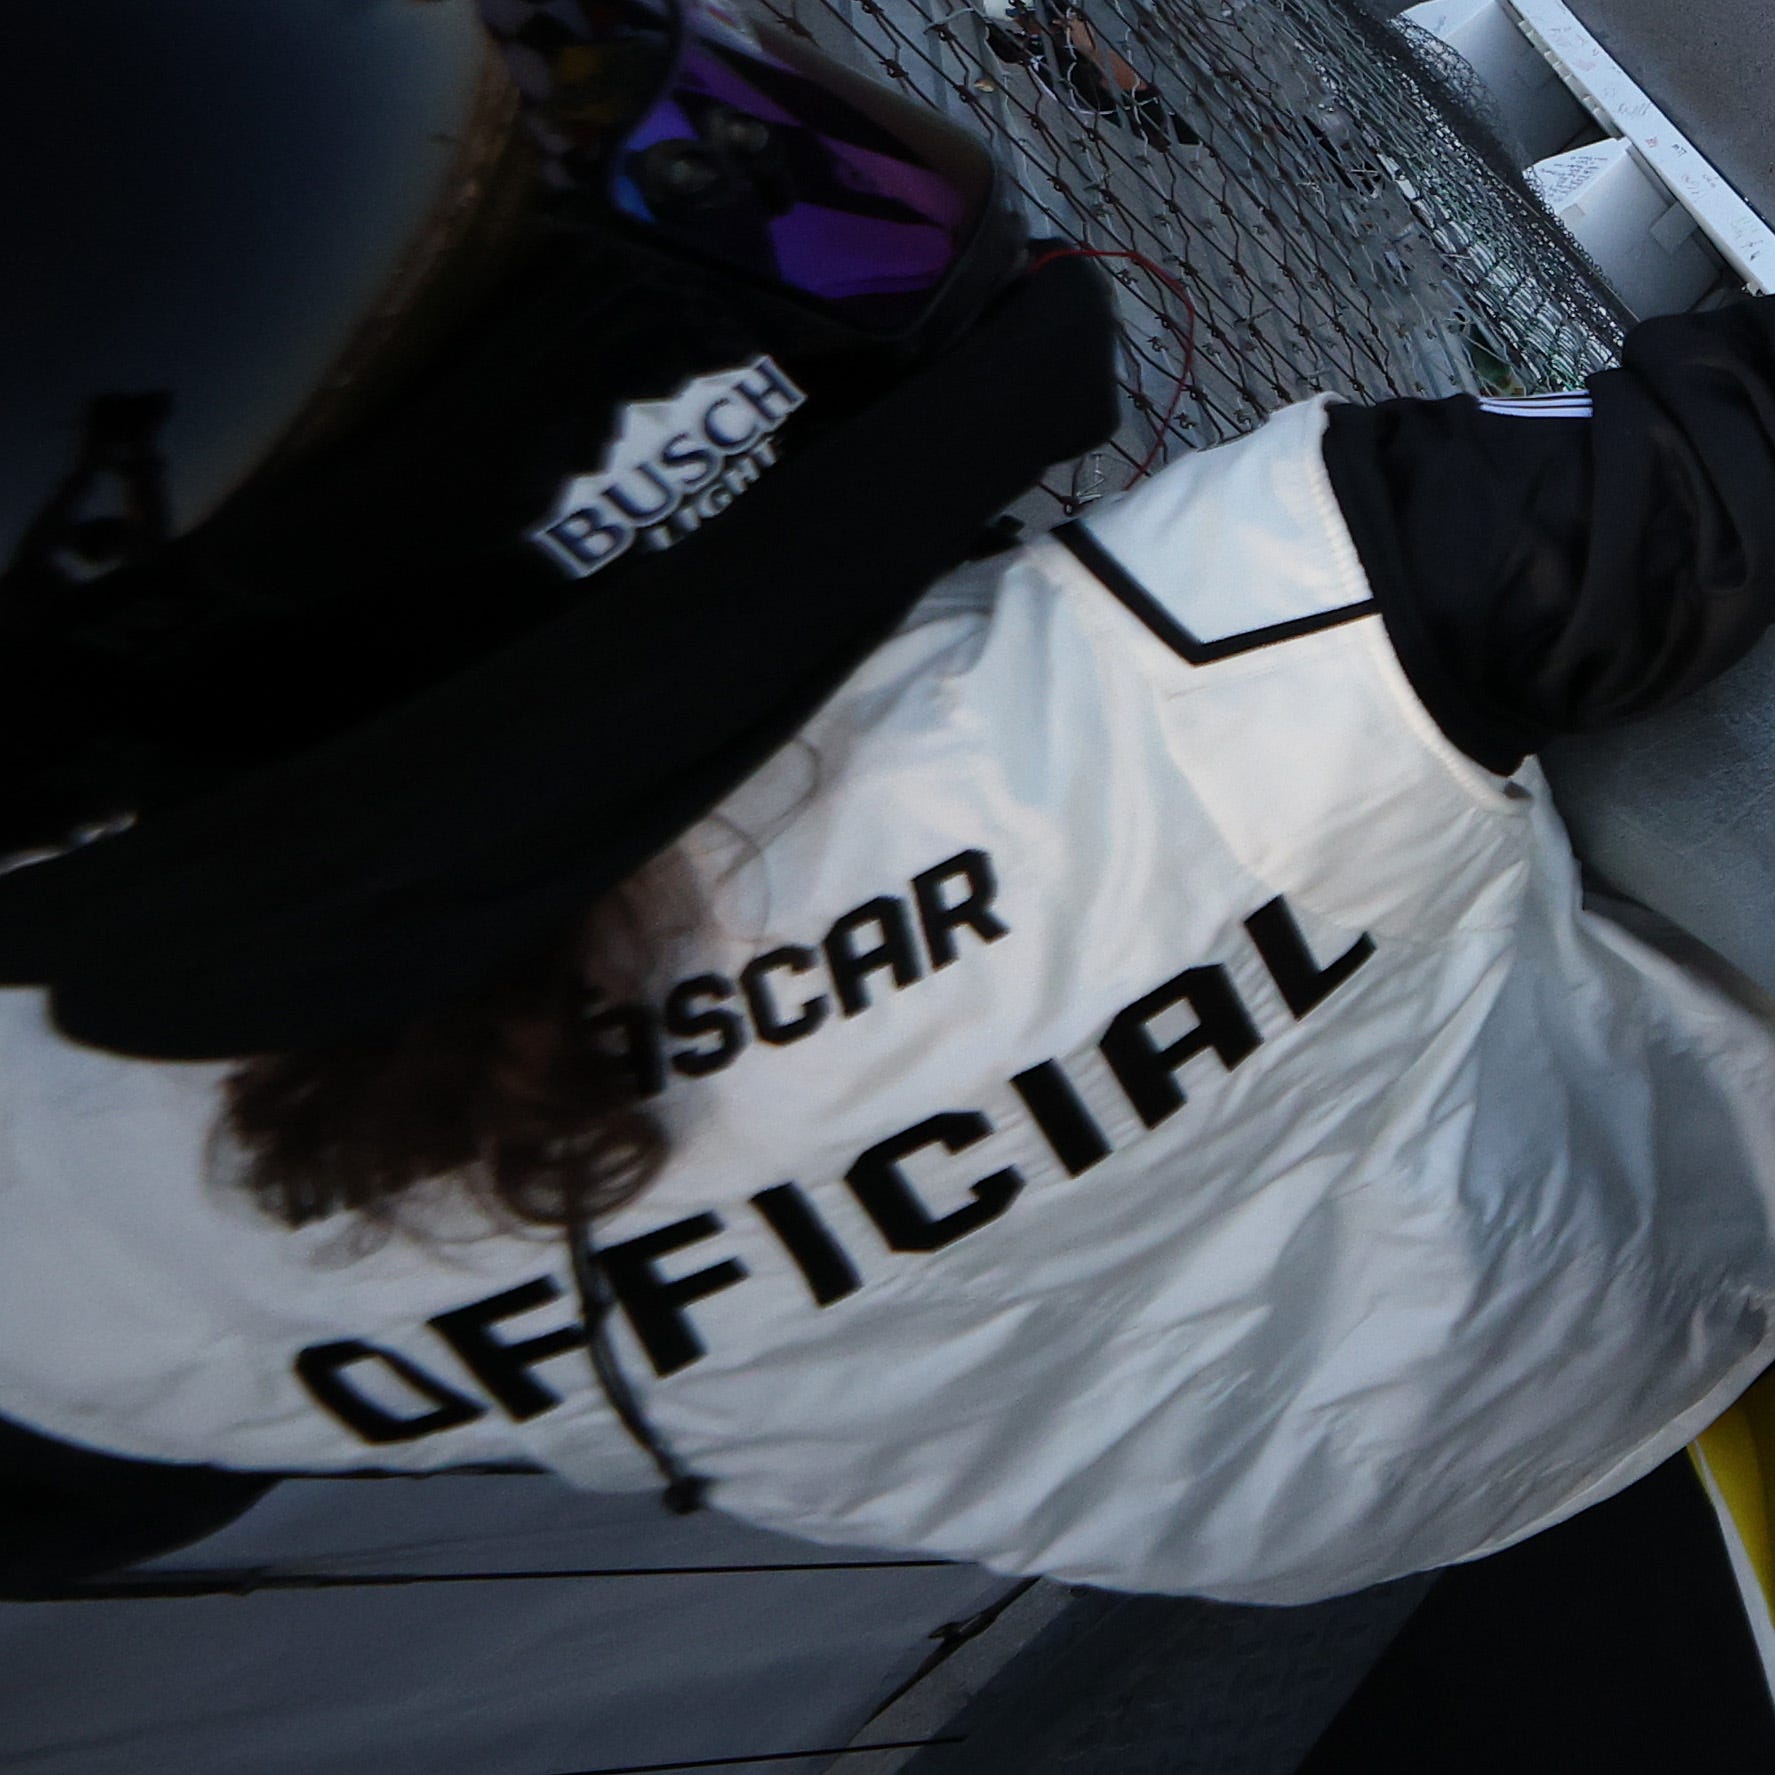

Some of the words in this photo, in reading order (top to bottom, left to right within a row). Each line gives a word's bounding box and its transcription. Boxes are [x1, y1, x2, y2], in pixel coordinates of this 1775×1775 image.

[544, 356, 804, 563] BUSCH
[648, 435, 777, 551] LIGHT
[590, 846, 1010, 1098] ASCAR
[295, 894, 1377, 1444] OFFICIAL
